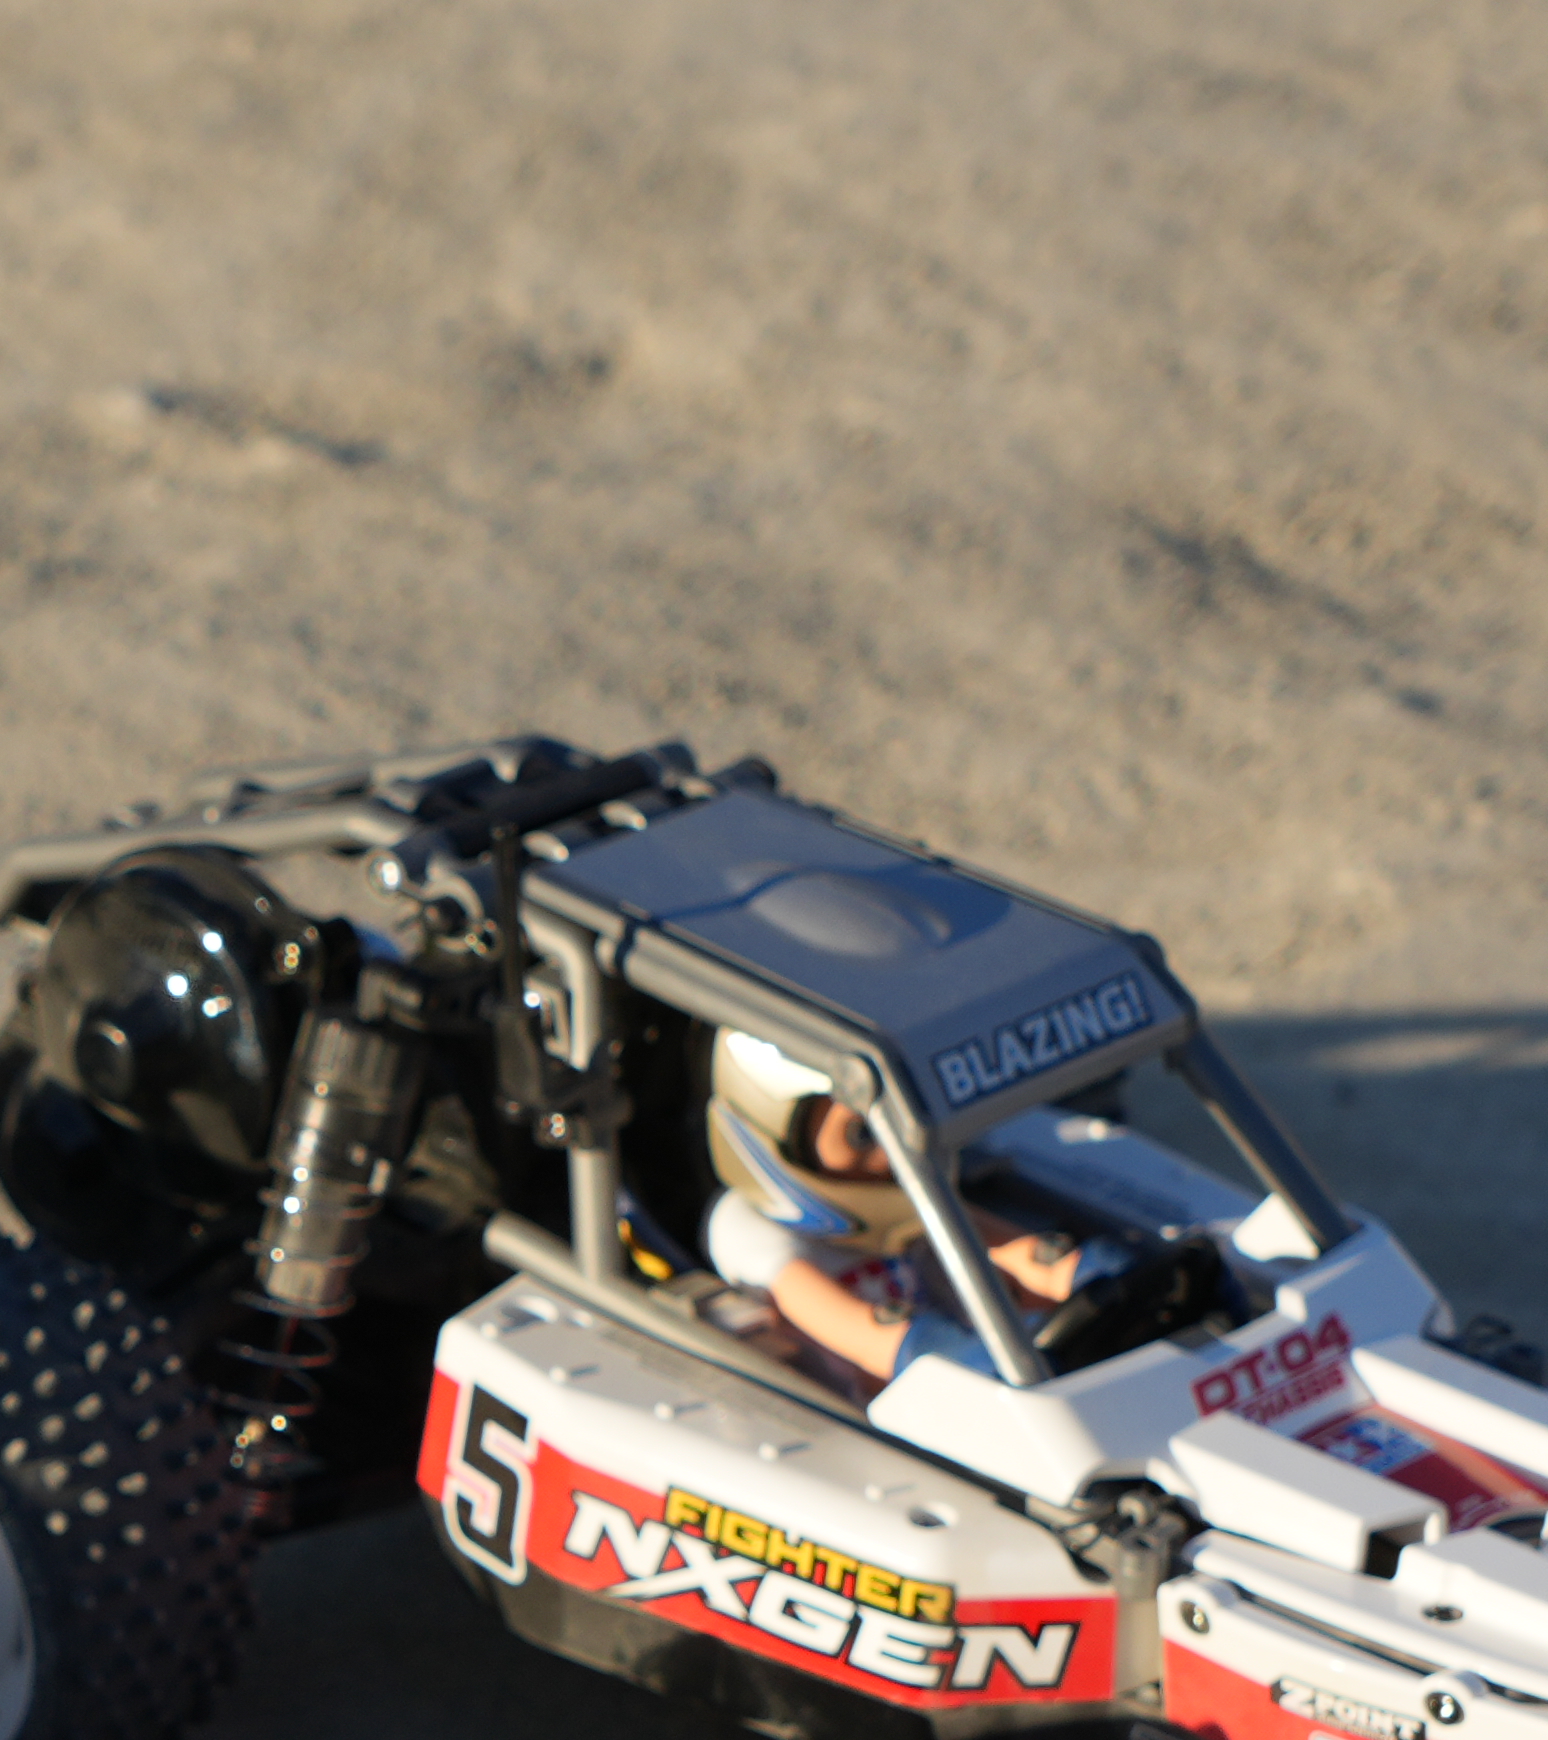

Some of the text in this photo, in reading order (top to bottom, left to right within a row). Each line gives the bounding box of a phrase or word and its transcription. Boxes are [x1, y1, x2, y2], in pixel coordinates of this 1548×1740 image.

[934, 974, 1151, 1105] BLAZING!
[1191, 1314, 1350, 1416] DT-04
[444, 1377, 535, 1584] 5
[564, 1491, 1078, 1690] NXGEN
[666, 1487, 955, 1623] FIGHTER
